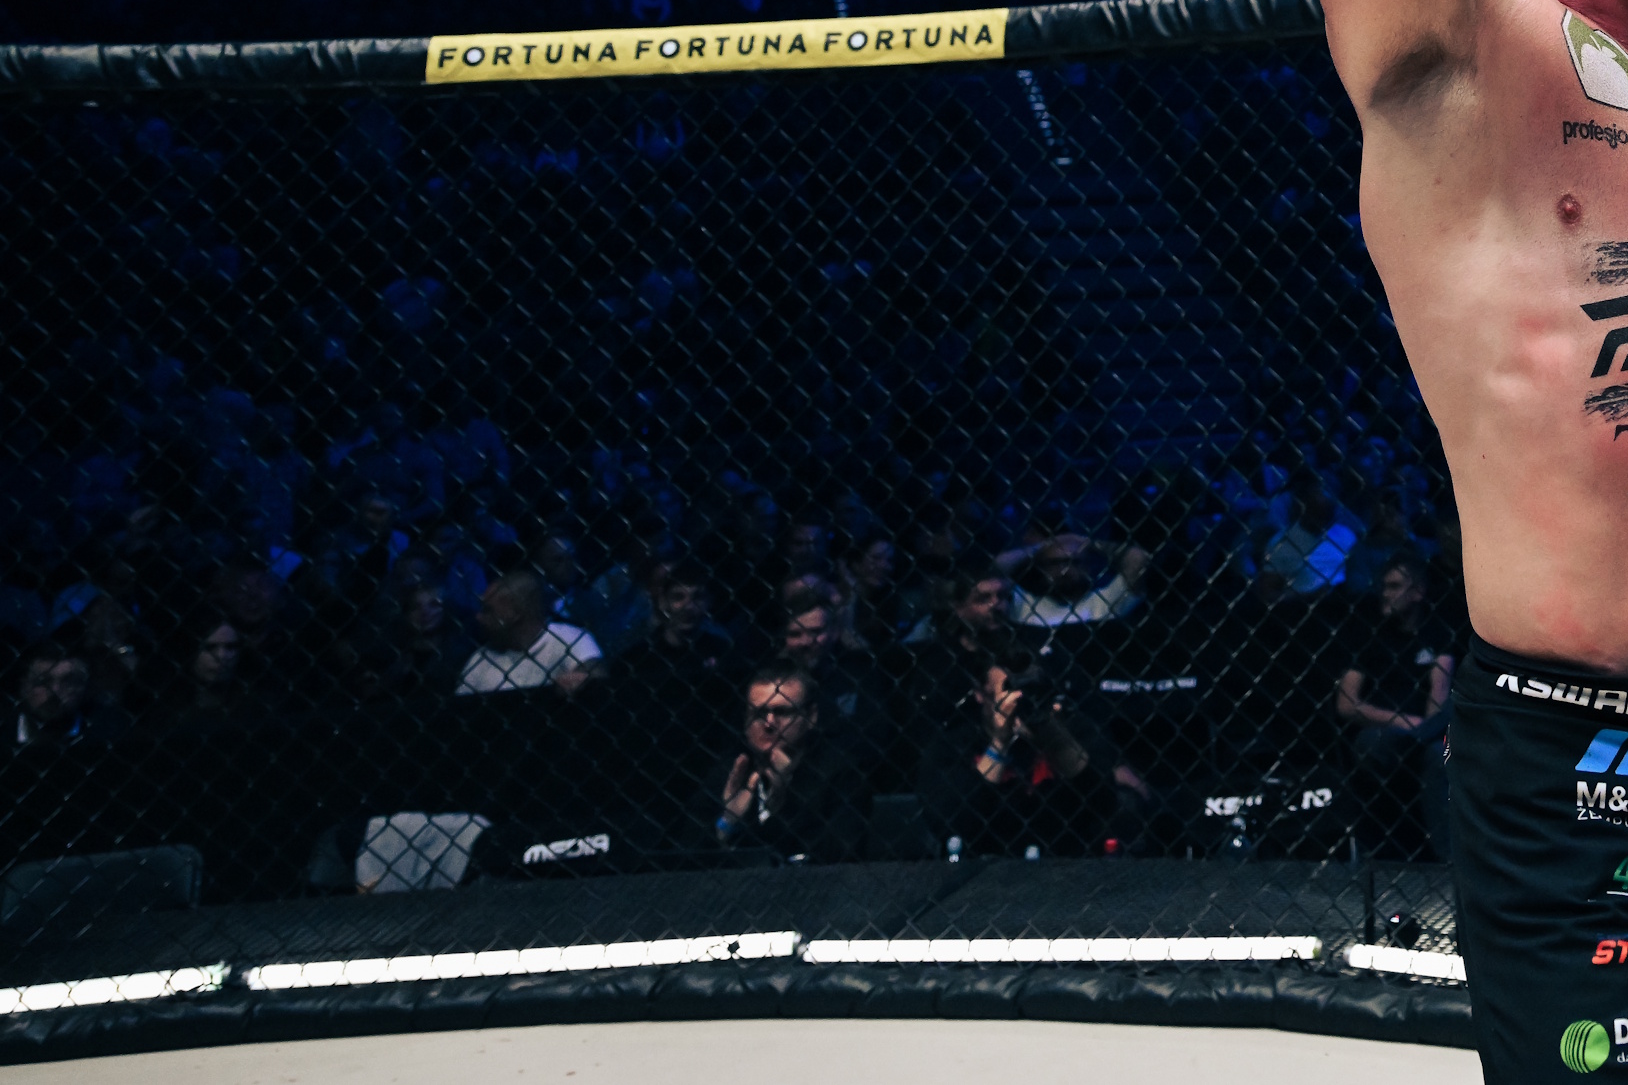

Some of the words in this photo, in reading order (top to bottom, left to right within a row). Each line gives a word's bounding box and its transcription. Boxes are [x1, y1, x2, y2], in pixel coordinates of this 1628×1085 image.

[438, 42, 617, 68] FORTUNA
[634, 34, 807, 60] FORTUNA
[823, 24, 993, 52] FORTUNA
